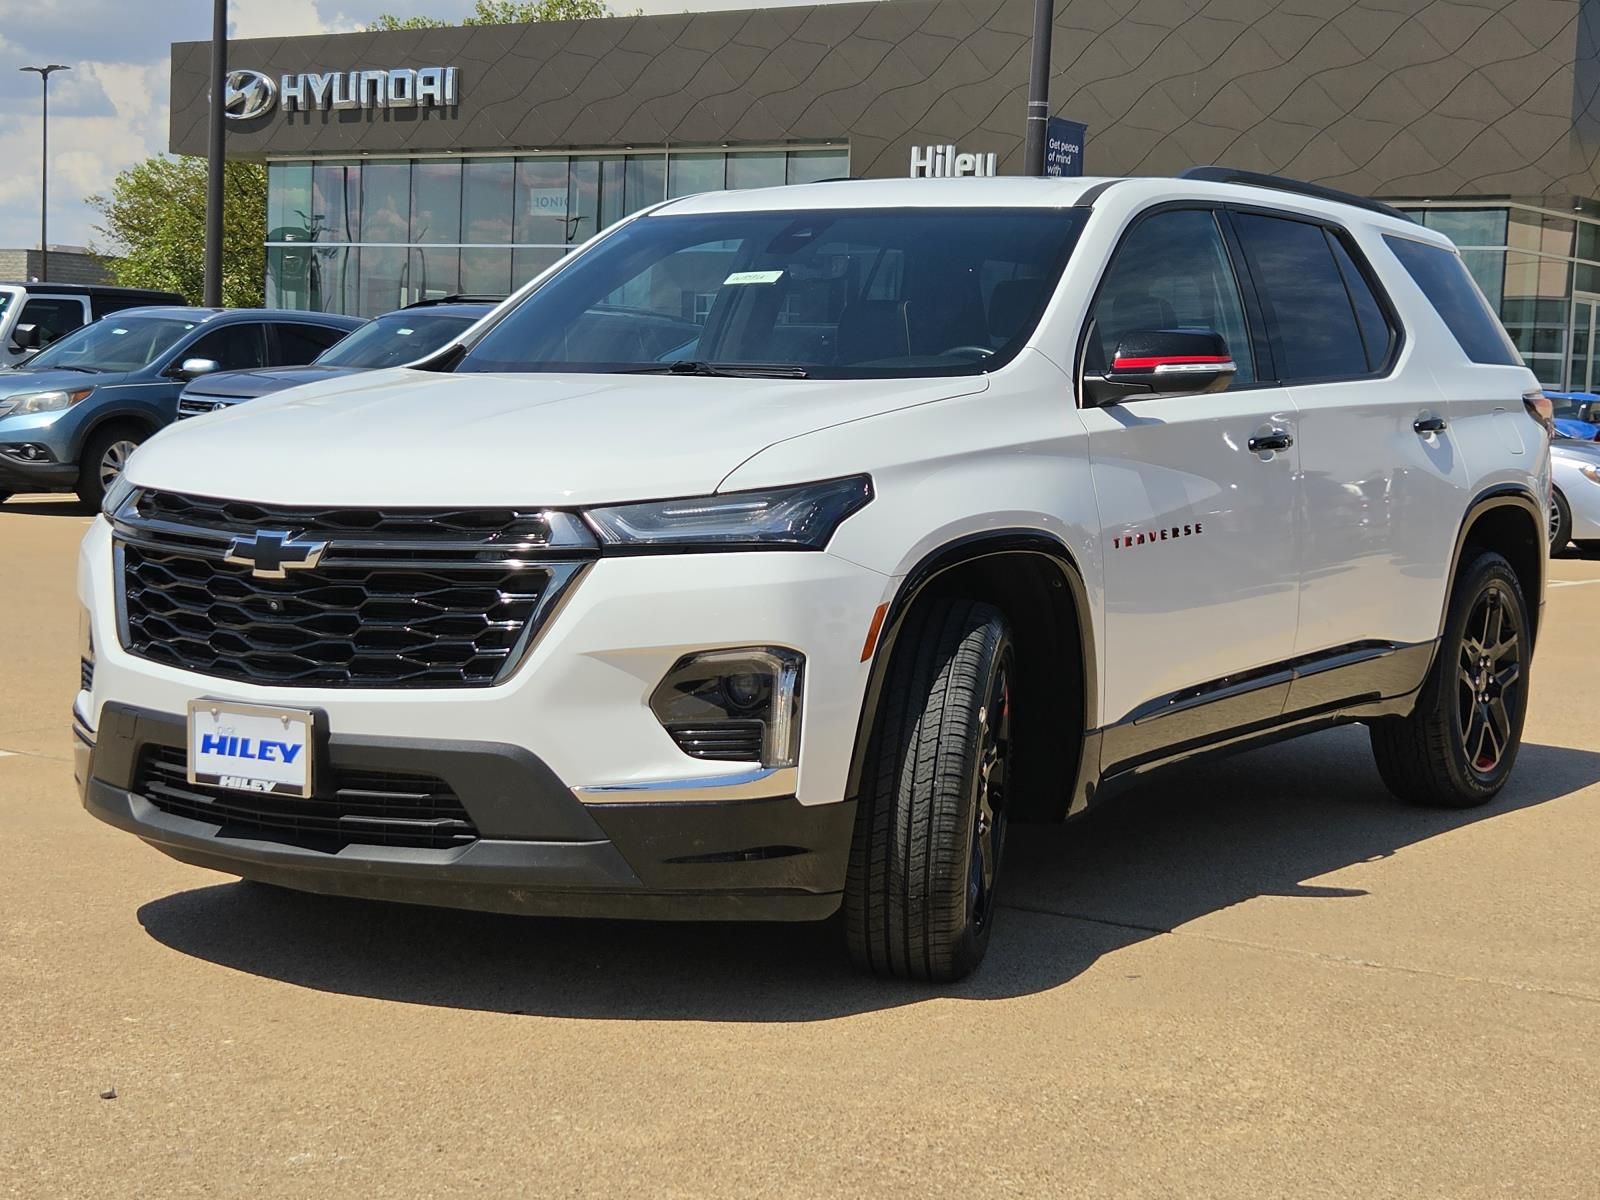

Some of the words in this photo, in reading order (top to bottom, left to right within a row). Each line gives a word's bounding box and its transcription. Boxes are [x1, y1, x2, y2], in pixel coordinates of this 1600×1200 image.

[281, 67, 460, 111] HYUNDAI
[1049, 138, 1060, 150] Get
[1061, 142, 1079, 154] peace
[1048, 151, 1056, 161] of
[1056, 153, 1071, 165] mind
[1113, 523, 1203, 549] TRAVERSE
[200, 733, 303, 764] HILEY
[219, 775, 277, 793] HILEY
